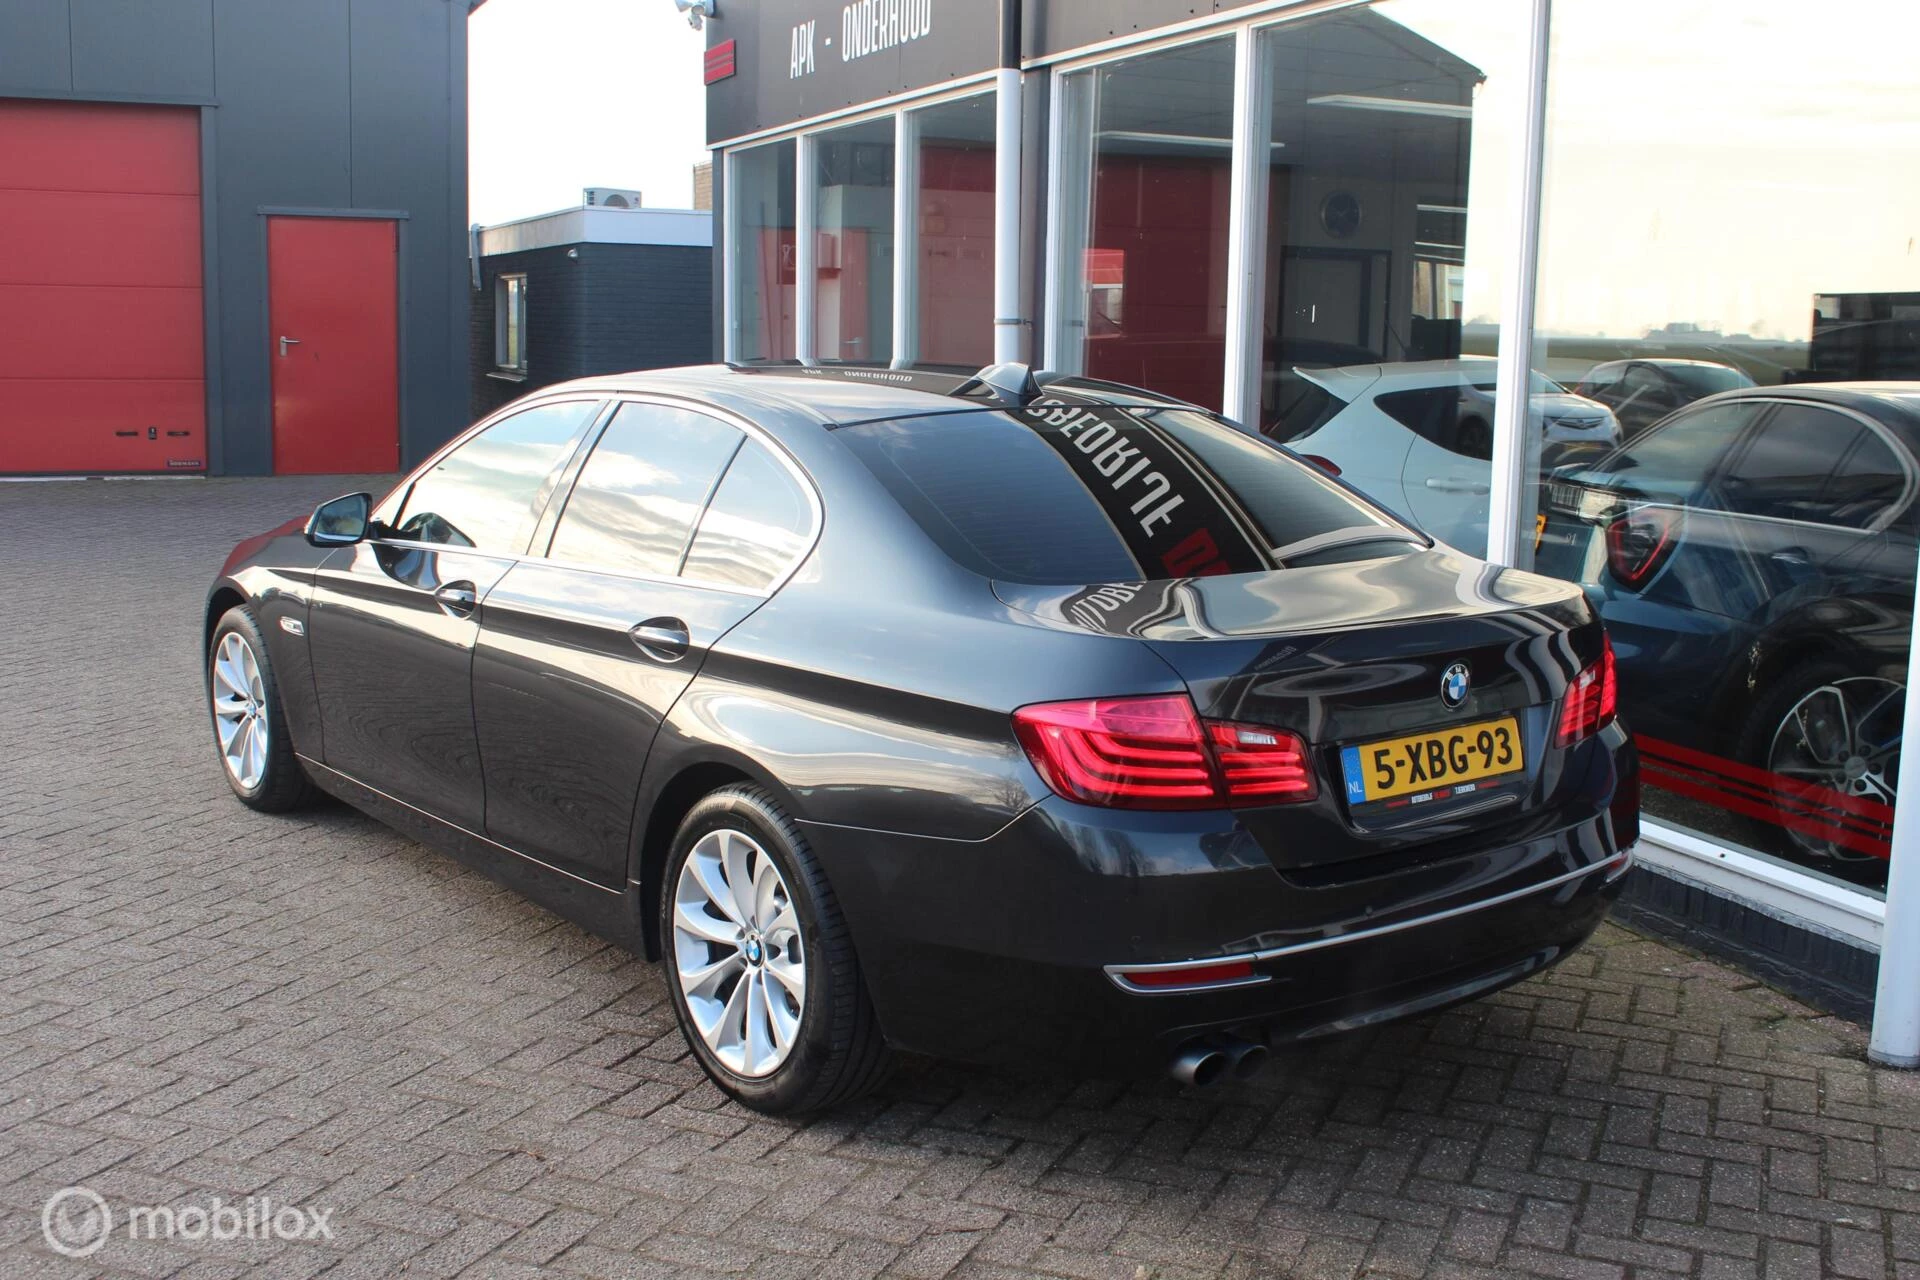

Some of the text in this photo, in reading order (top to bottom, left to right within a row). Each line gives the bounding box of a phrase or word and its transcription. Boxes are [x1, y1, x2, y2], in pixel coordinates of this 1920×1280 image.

[790, 19, 816, 80] APK
[842, 0, 931, 62] ONDERHOUD
[1348, 781, 1363, 794] NL
[1374, 727, 1513, 790] 5-XBG-93
